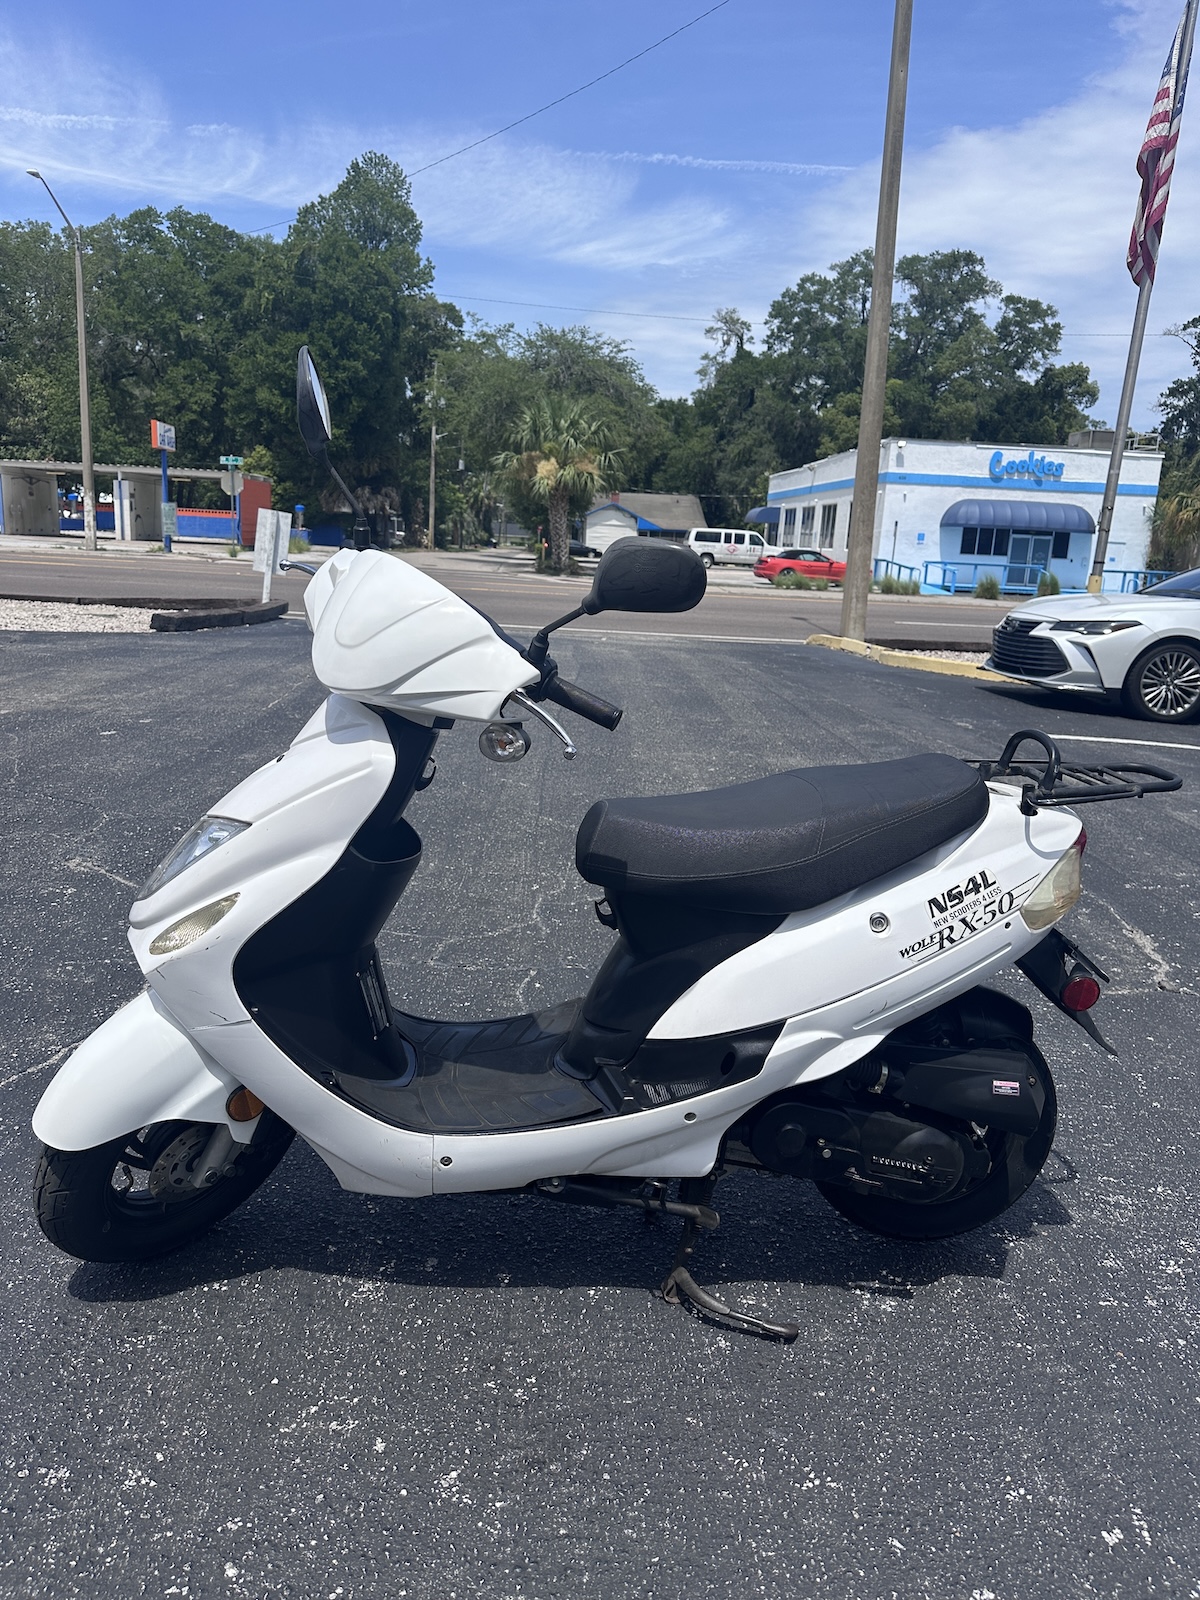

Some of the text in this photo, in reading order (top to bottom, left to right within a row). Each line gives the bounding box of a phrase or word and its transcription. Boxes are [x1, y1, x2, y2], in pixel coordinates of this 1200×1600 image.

[989, 450, 1065, 478] Cookies
[927, 870, 997, 919] NS4L
[933, 916, 949, 929] NEW
[950, 899, 982, 921] SCOOTERS
[987, 886, 1002, 900] LESS
[899, 891, 1014, 959] WOLF RX-50
